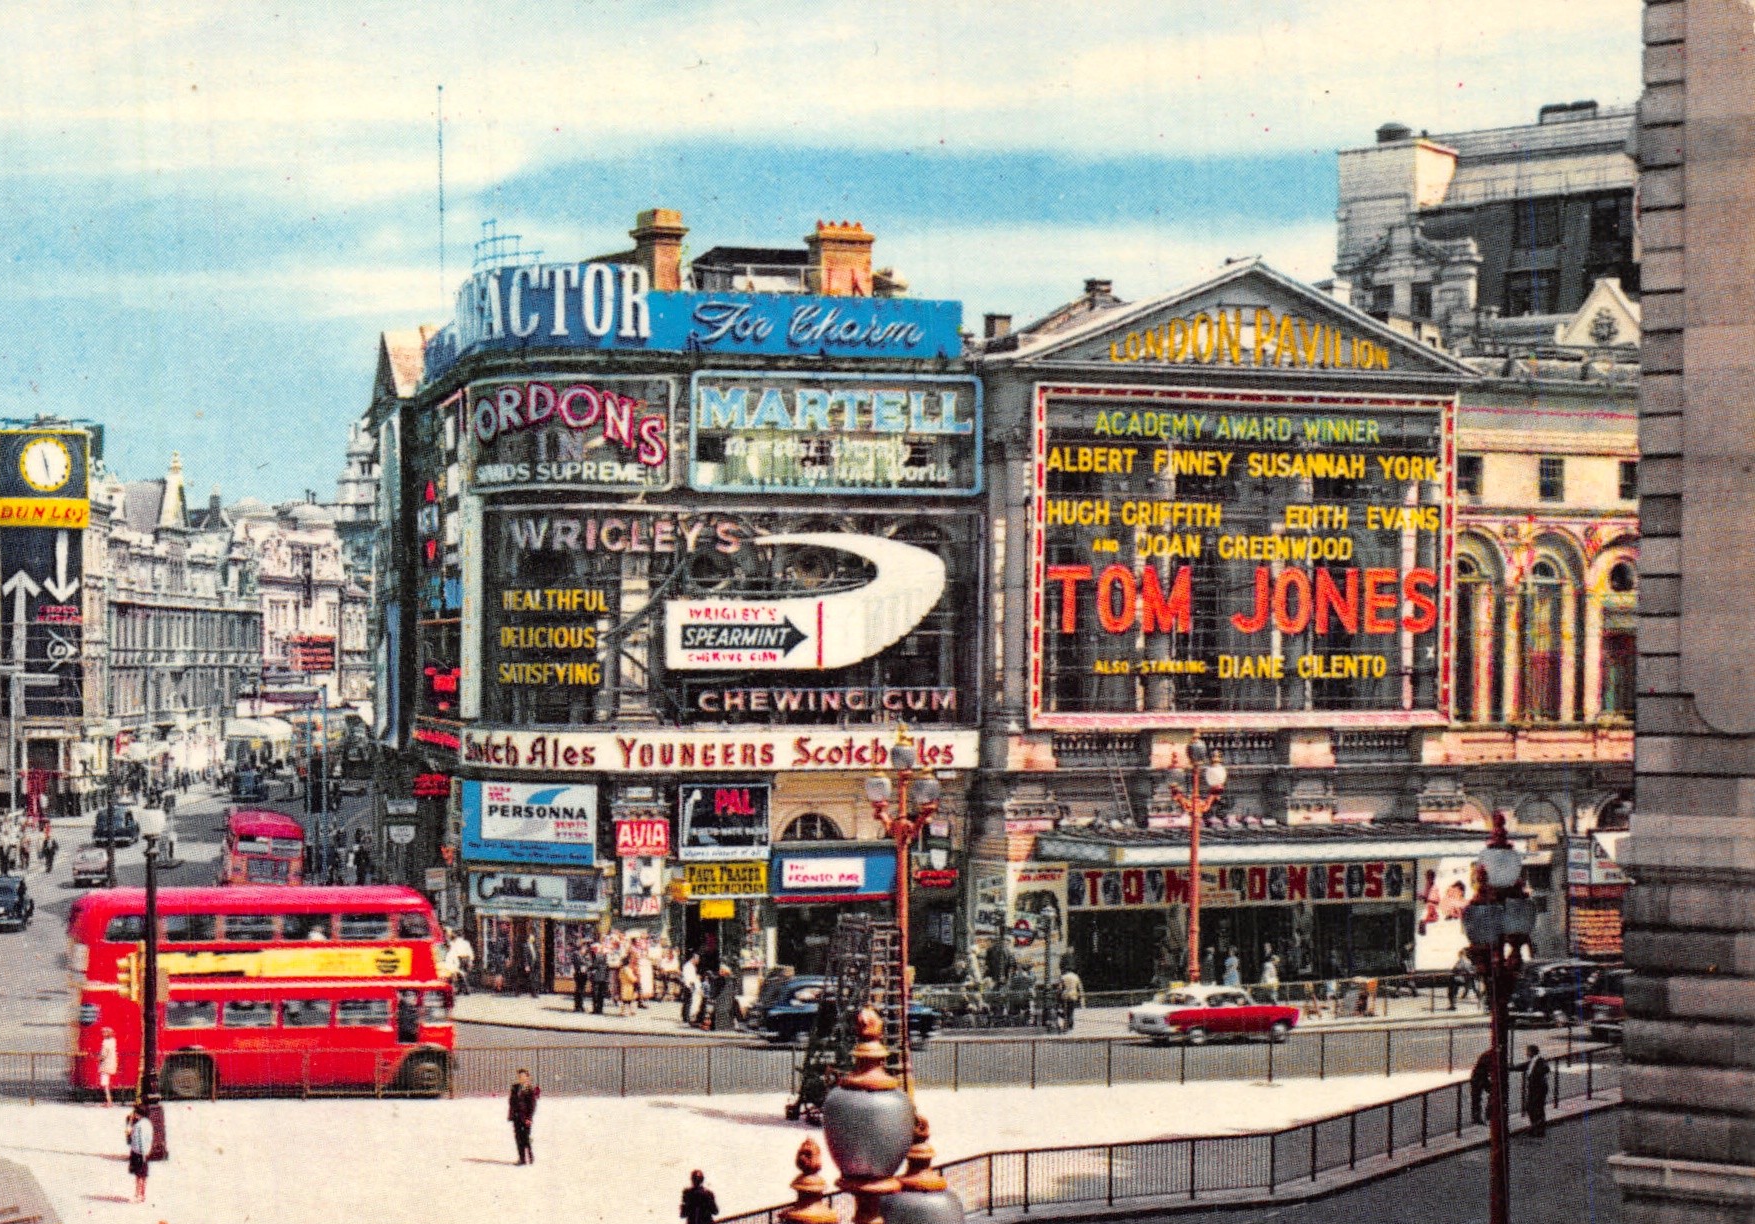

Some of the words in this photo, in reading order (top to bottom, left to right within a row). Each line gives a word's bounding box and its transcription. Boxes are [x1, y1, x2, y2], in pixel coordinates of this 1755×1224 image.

[789, 305, 925, 346] Charm
[1110, 308, 1243, 366] LONDON
[1254, 308, 1389, 371] PAVILION
[699, 386, 973, 434] MARTELL
[1094, 411, 1206, 440] ACADEMY
[1216, 415, 1291, 442] AWARD
[1304, 418, 1379, 444] WINNER
[536, 461, 645, 482] SUPREME
[1047, 447, 1138, 473] ALBERT
[1154, 451, 1234, 476] FINNEY
[1248, 453, 1365, 480] SUSANNAH
[1378, 456, 1440, 481] YORK
[1046, 499, 1110, 525] HUGH
[1122, 502, 1221, 528] GRIFFITH
[1285, 505, 1348, 530] EDITH
[1367, 506, 1440, 532] EVANS
[510, 518, 741, 554] WRIGLEY'S
[1092, 539, 1121, 553] AND
[1219, 535, 1353, 561] GREENWOOD
[502, 588, 609, 612] HEALTHFUL
[1046, 564, 1192, 635] TOM
[1230, 565, 1439, 636] JONES
[501, 627, 596, 649] DELICIOUS
[685, 627, 792, 647] SPEARMINT
[499, 663, 601, 685] SATISFYING
[1218, 655, 1285, 679] DIANE
[1297, 655, 1387, 679] CILENTO
[698, 689, 865, 712] CHEWING
[883, 688, 957, 711] GUM
[527, 735, 596, 766] Ales
[616, 735, 775, 768] YOUNGERS
[793, 736, 888, 766] Scotch
[918, 737, 954, 765] les
[488, 804, 588, 820] PERSONNA
[715, 789, 756, 816] PAL
[618, 823, 667, 848] AVIA
[624, 895, 660, 913] AVIA
